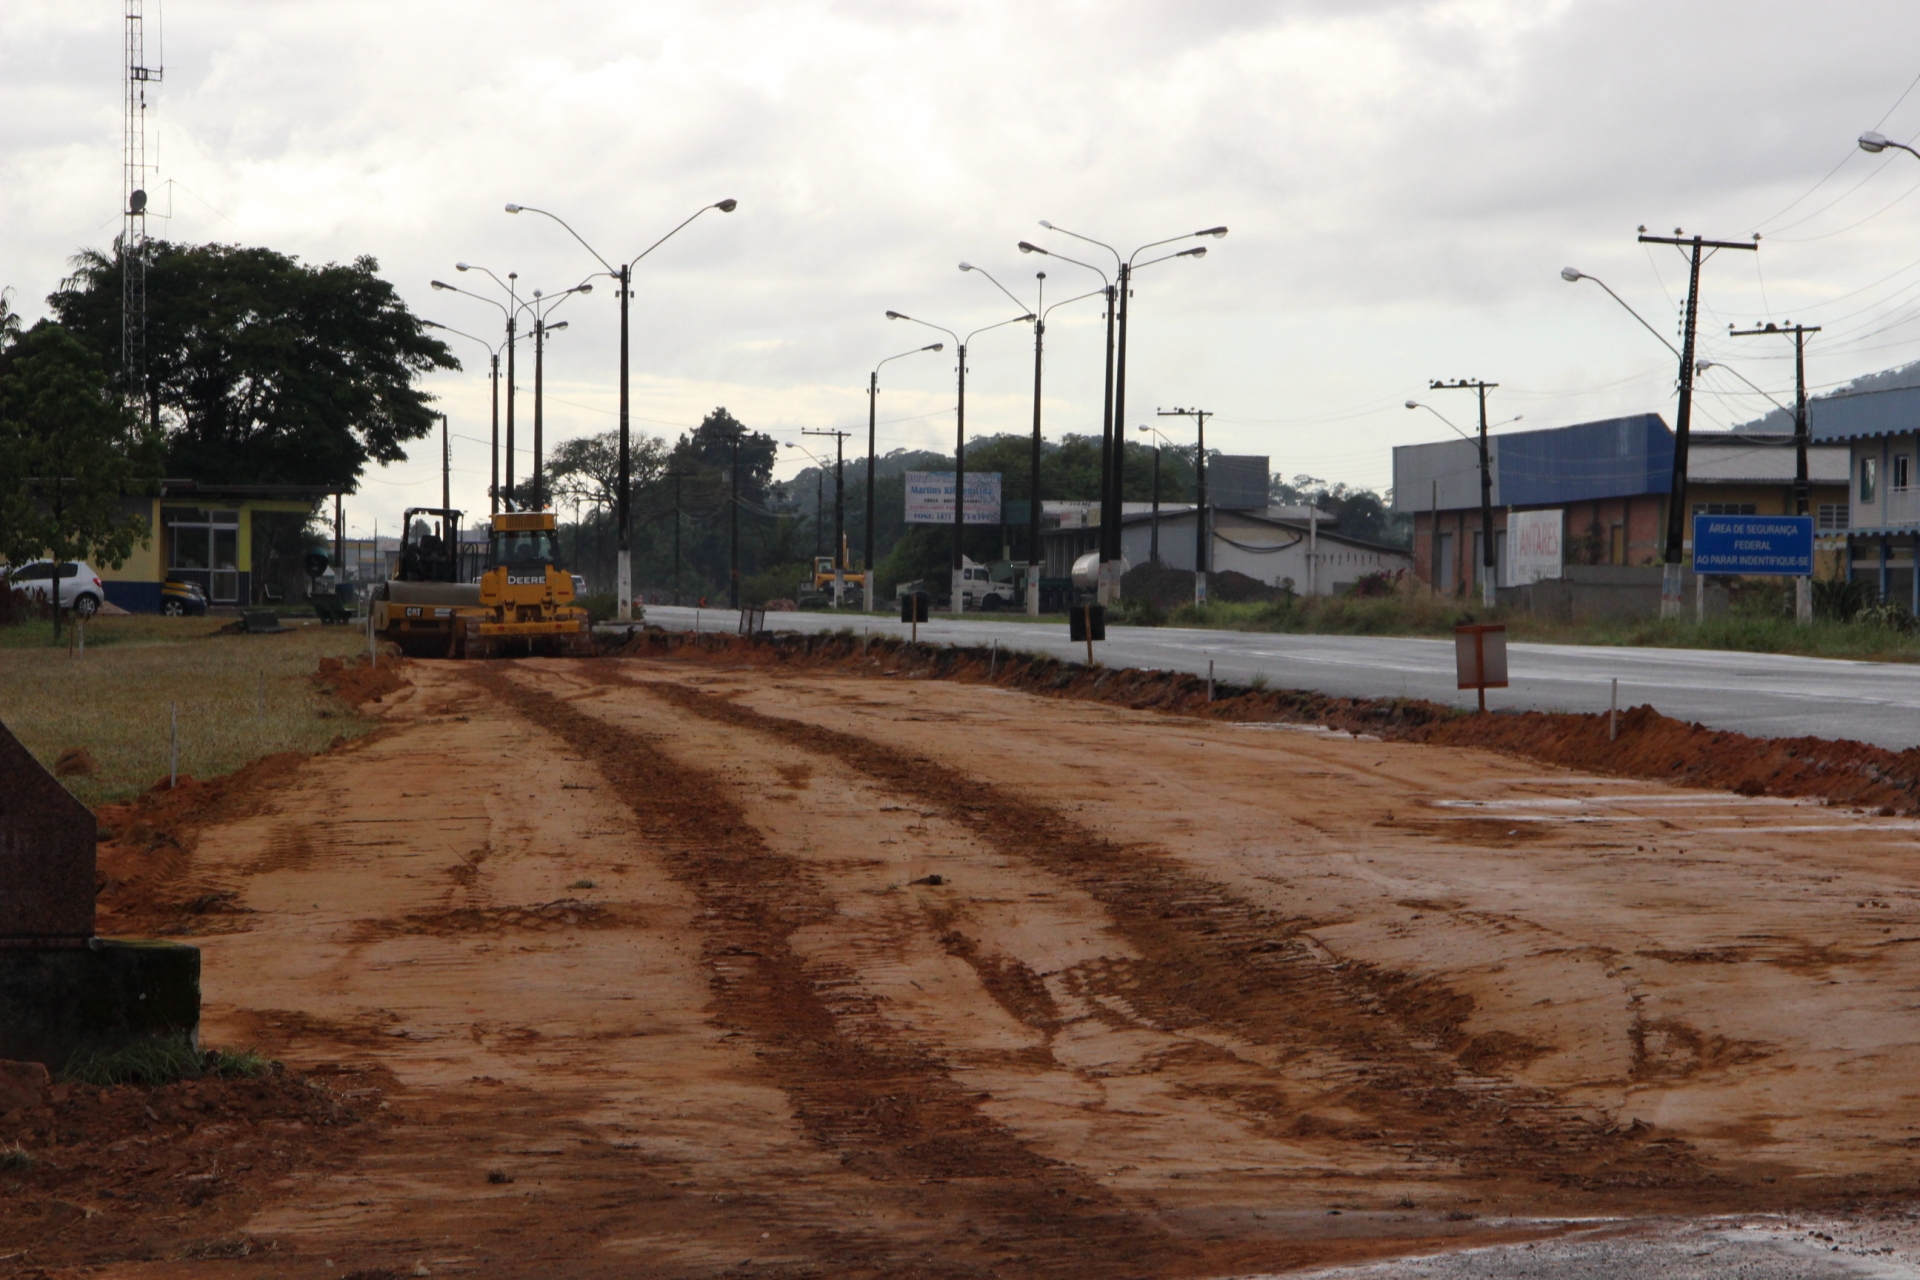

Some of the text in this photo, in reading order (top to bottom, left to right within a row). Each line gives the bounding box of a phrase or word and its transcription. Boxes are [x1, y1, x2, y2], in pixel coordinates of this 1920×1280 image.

[911, 486, 941, 495] Martins
[1709, 522, 1798, 536] ÁREA DE SEGURANÇA
[1520, 522, 1558, 556] ANTARES
[1734, 540, 1772, 550] FEDERAL
[1697, 555, 1809, 566] AO PARAR INDENTIFIQUE-SE
[507, 575, 546, 584] DEERE
[406, 607, 421, 617] CAT
